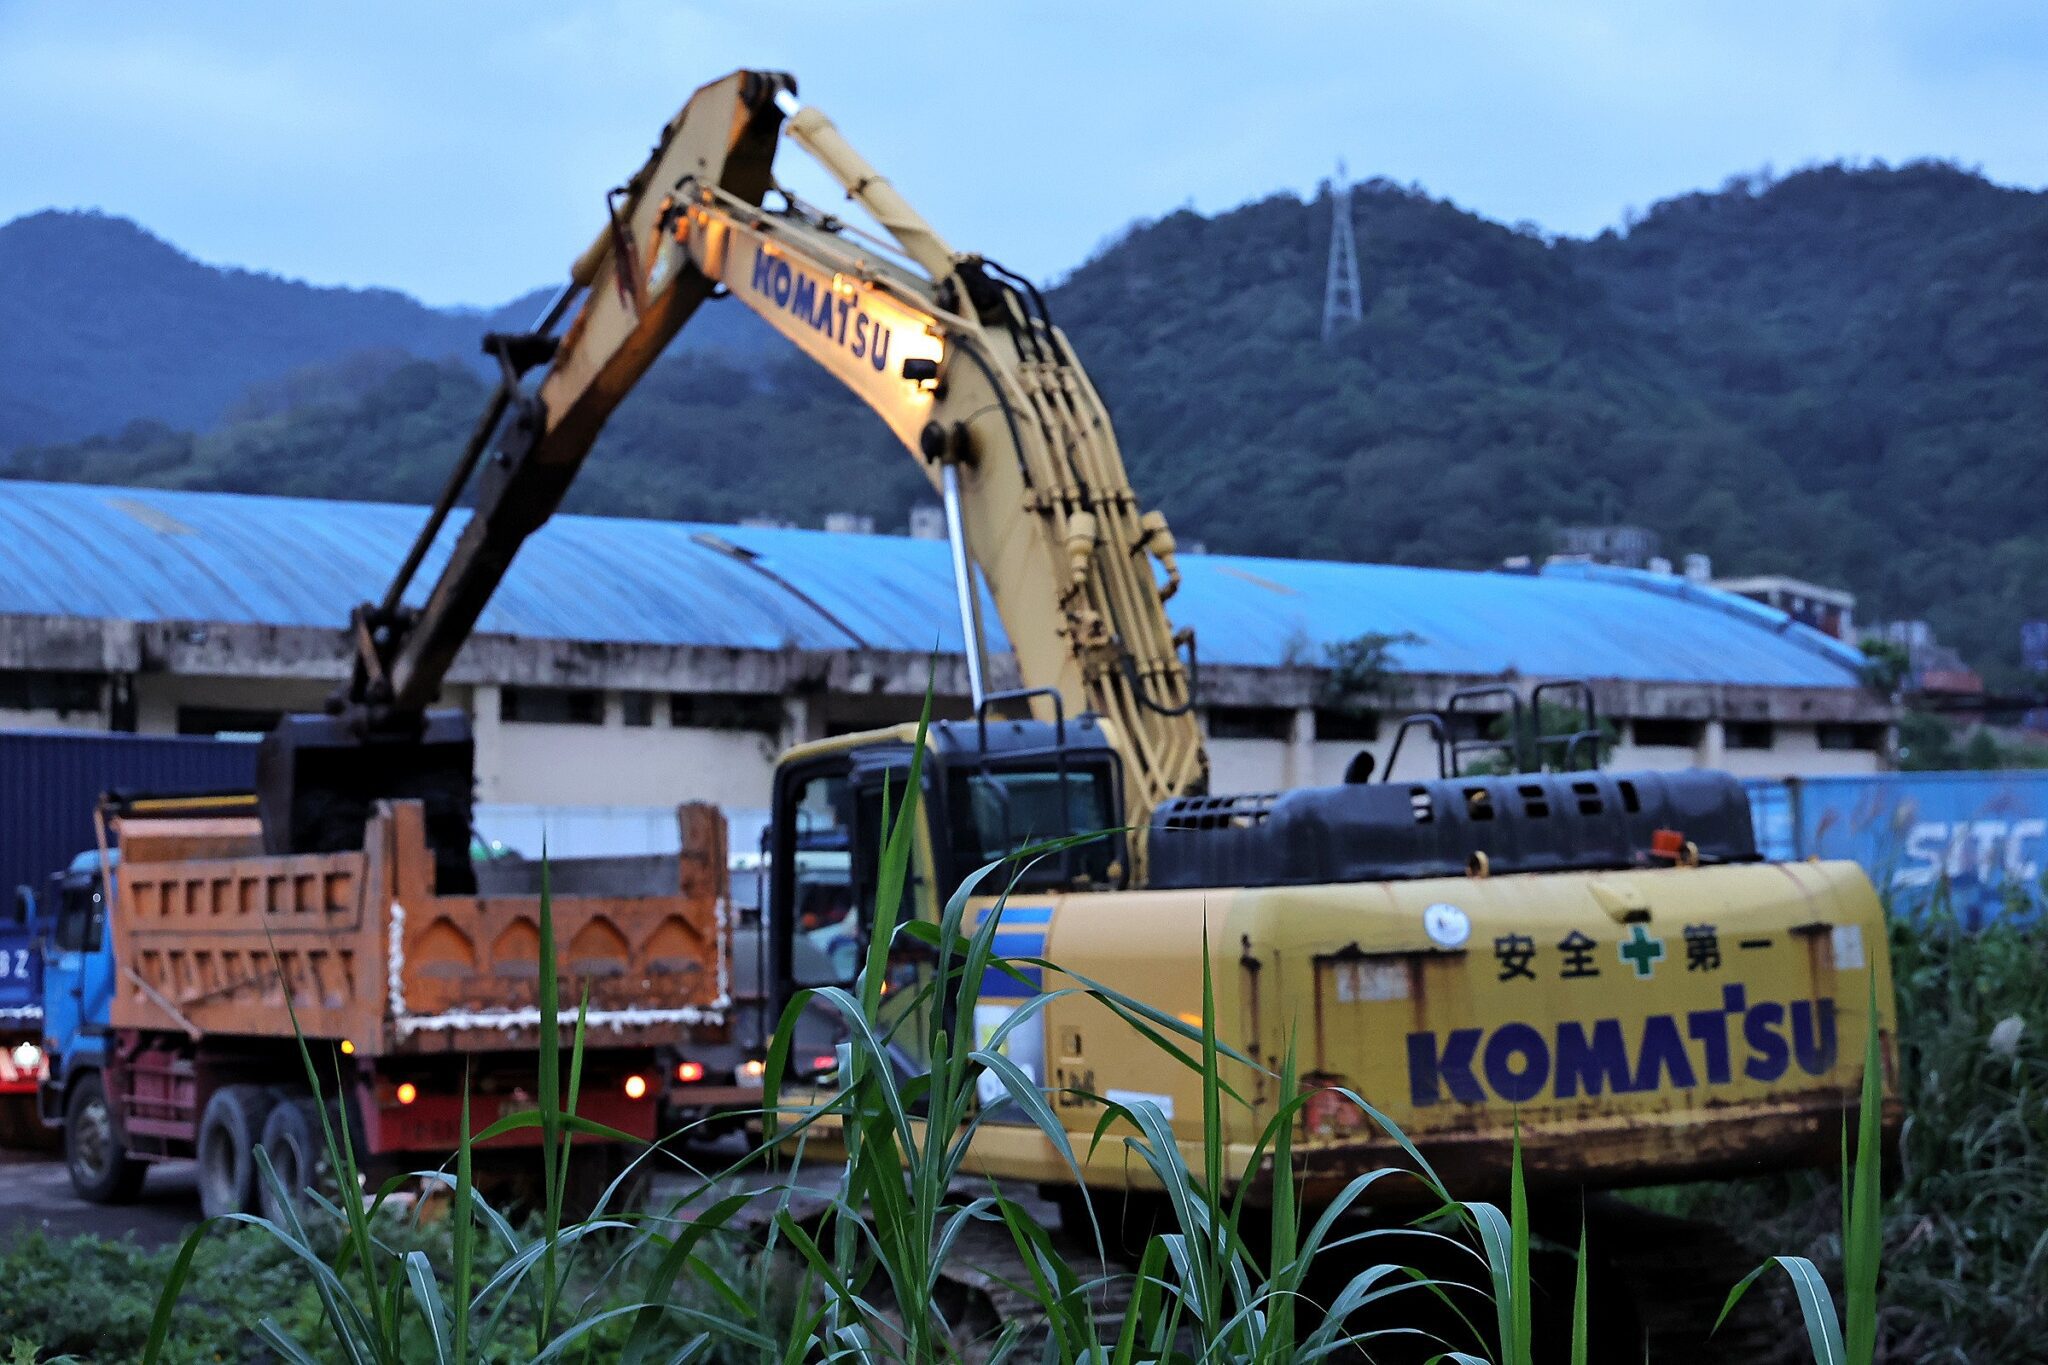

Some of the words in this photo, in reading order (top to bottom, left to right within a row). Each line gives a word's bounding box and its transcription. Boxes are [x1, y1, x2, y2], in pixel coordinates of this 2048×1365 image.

[752, 246, 891, 371] KOMATSU
[1892, 819, 2046, 887] SITC
[1406, 983, 1838, 1108] KOMATSU
